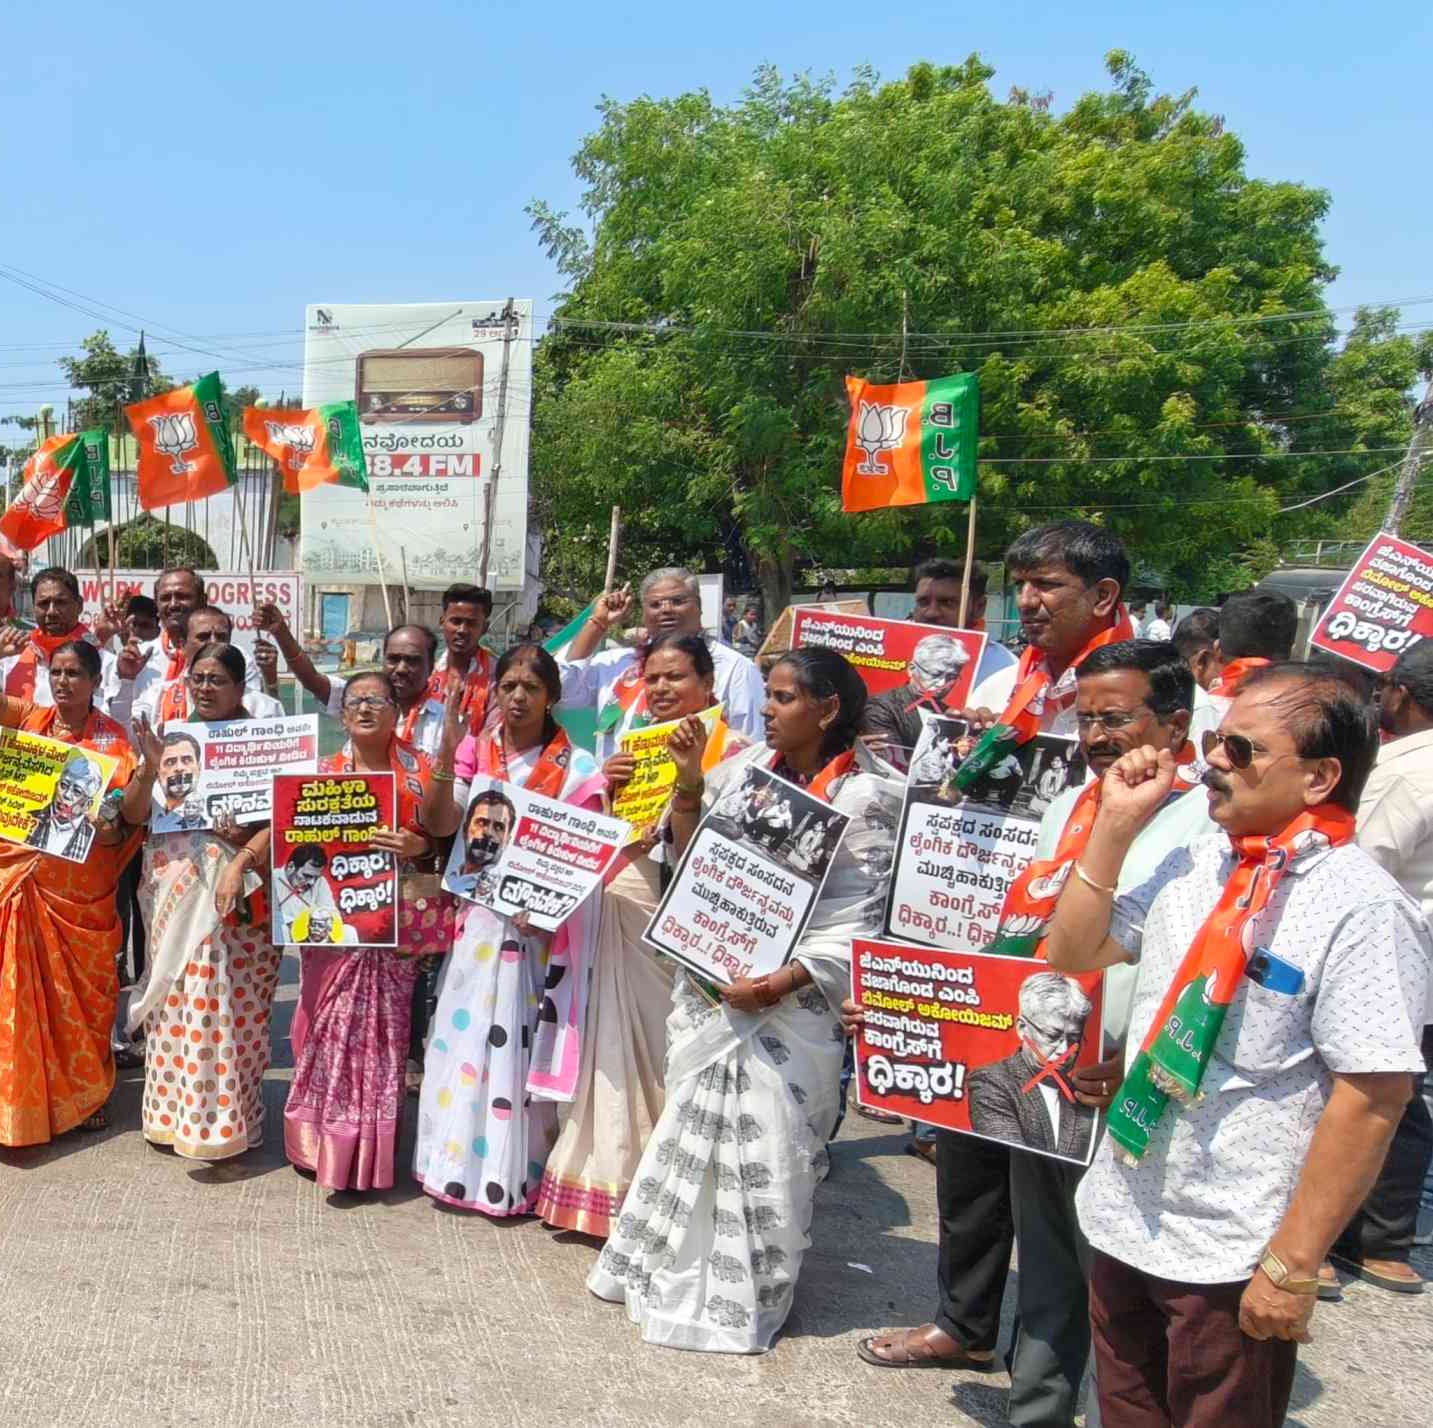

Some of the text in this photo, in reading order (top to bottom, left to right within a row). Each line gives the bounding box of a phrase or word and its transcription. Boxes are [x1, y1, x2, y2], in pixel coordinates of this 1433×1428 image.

[429, 455, 474, 477] FM
[207, 582, 292, 605] OGRESS
[1328, 611, 1423, 653] ಧಿಕ್ಕಾರ!
[302, 780, 367, 797] ಮಹಿಳಾ
[285, 828, 340, 843] ರಾಹುಲ್
[910, 832, 952, 857] ಲೈಂಗಿಕ
[331, 851, 391, 881] ಧಿಕ್ಕಾರ!
[690, 854, 724, 884] ಲೈಂಗಿಕ
[748, 862, 795, 896] ಸಂಸದನ
[340, 880, 393, 914] ಧಿಕ್ಕಾರ!
[692, 909, 758, 955] ಕಾಂಗ್ರೆಸ್‌ಗೆ
[860, 973, 981, 1005] ವಜಾಗೊಂಡ ಎಂಪಿ
[861, 990, 915, 1012] ಬಿಮೋಲ್
[863, 1010, 940, 1038] ಪರವಾಗಿರುವ
[864, 1027, 942, 1060] ಕಾಂಗ್ರೆಸ್‌ಗೆ
[867, 1054, 966, 1104] ಧಿಕ್ಕಾರ!
